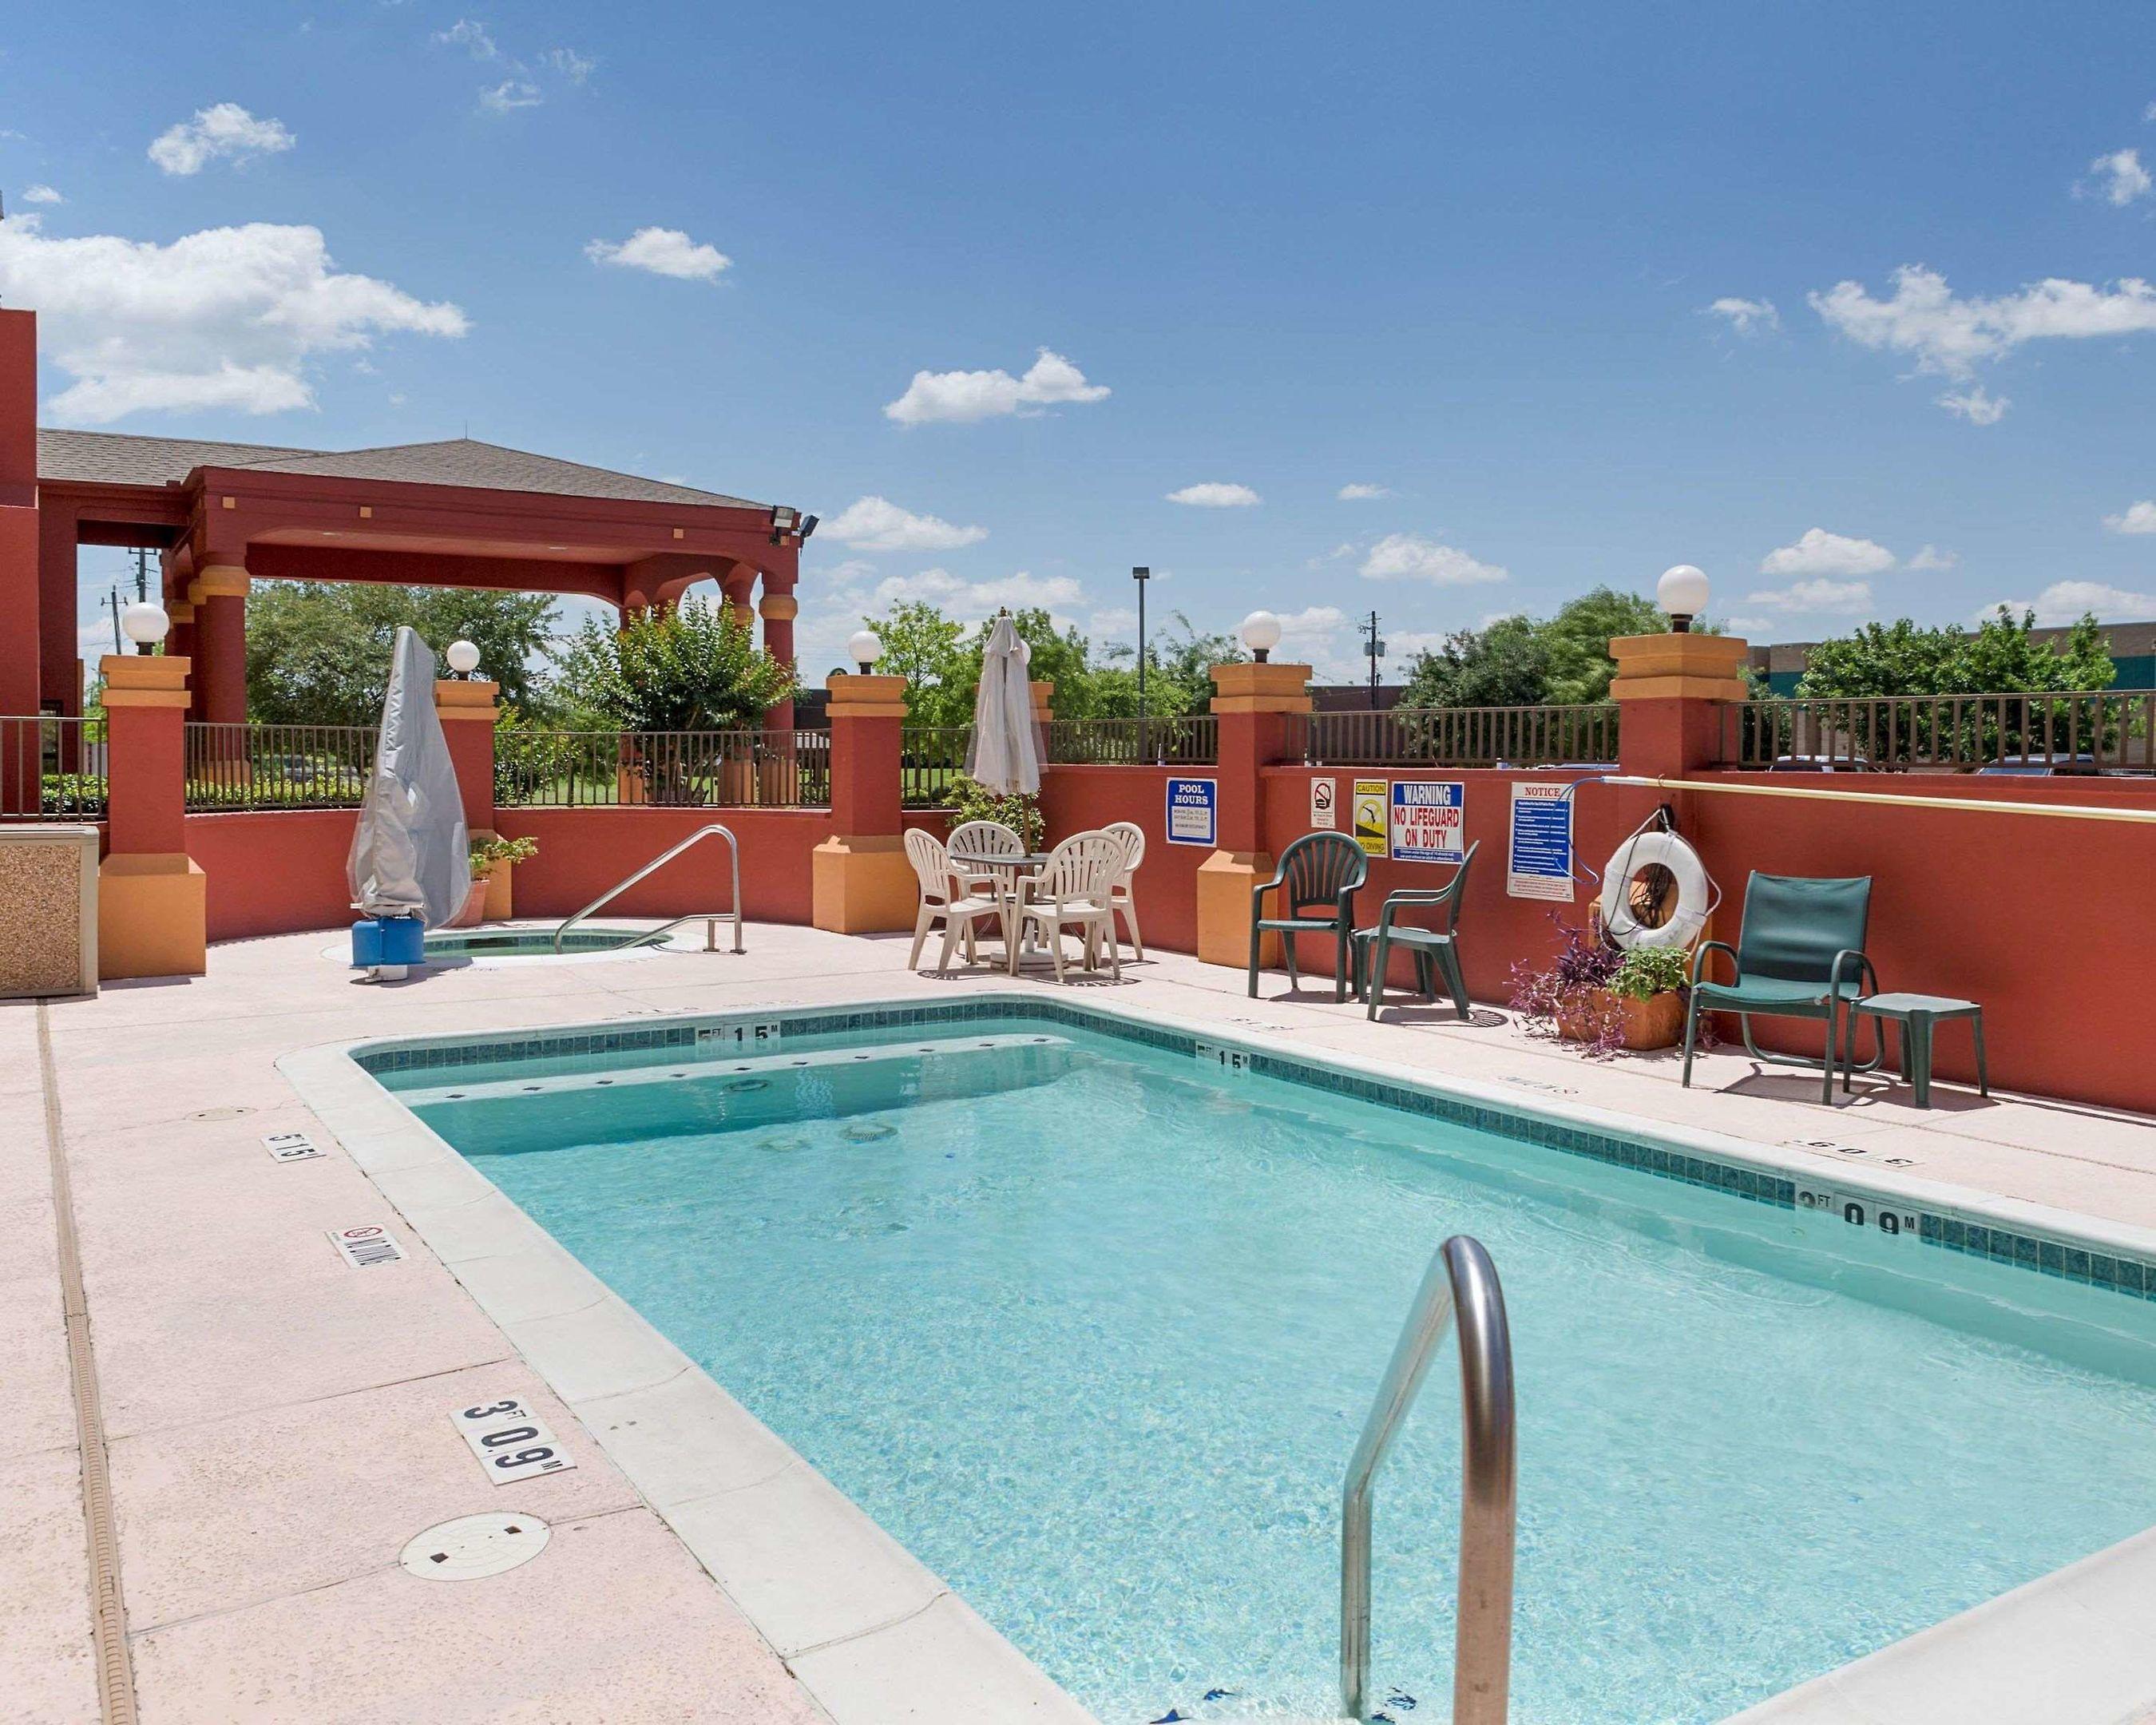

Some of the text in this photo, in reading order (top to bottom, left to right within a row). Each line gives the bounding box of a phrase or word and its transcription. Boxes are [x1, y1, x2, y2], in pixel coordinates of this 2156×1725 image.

[1179, 784, 1204, 794] POOL
[1525, 787, 1560, 797] NOTICE
[1175, 795, 1208, 805] HOURS
[1404, 785, 1451, 805] WARNING
[1394, 807, 1459, 827] NO LIFEGUARD
[1405, 829, 1447, 848] ON DUTY
[1366, 843, 1385, 852] DIVING
